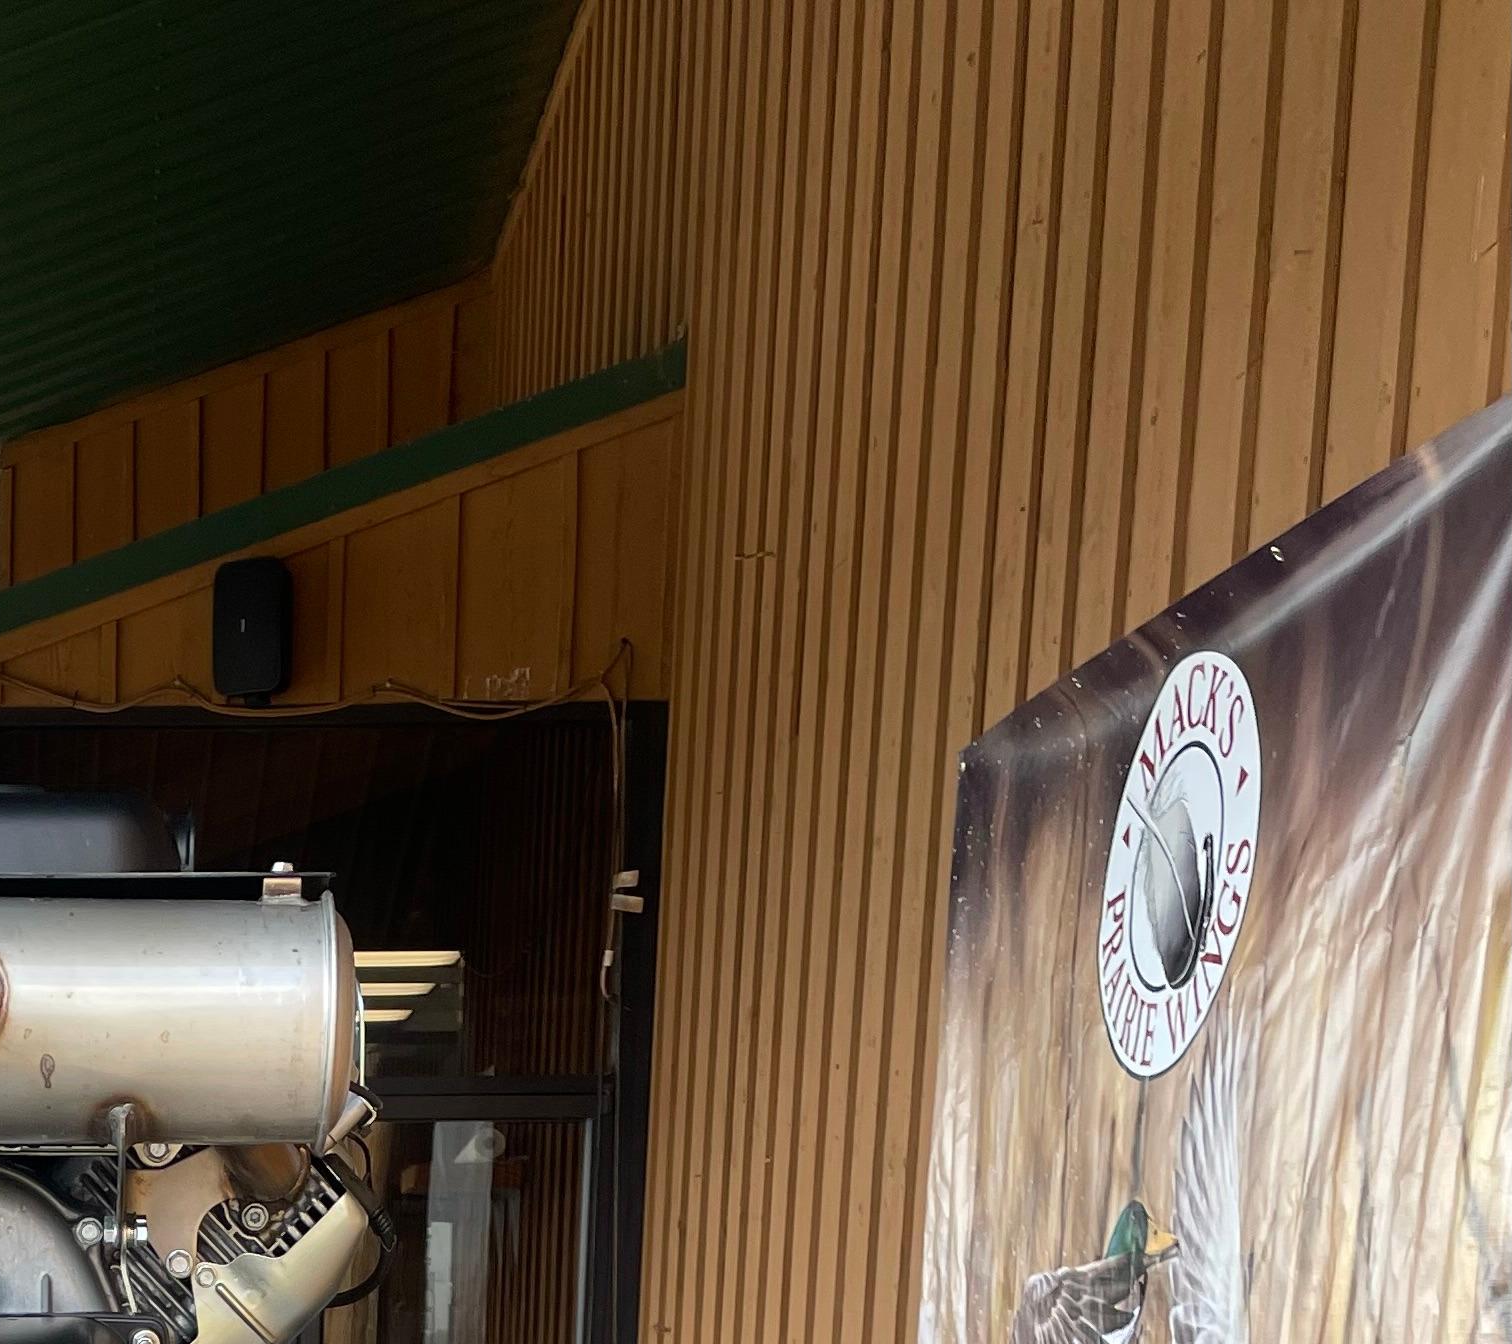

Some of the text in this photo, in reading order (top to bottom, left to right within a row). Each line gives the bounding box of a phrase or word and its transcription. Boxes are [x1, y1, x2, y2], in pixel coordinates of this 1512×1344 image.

[1139, 661, 1244, 798] MACK'S
[1102, 839, 1251, 1066] PRAIRIE WINGS
